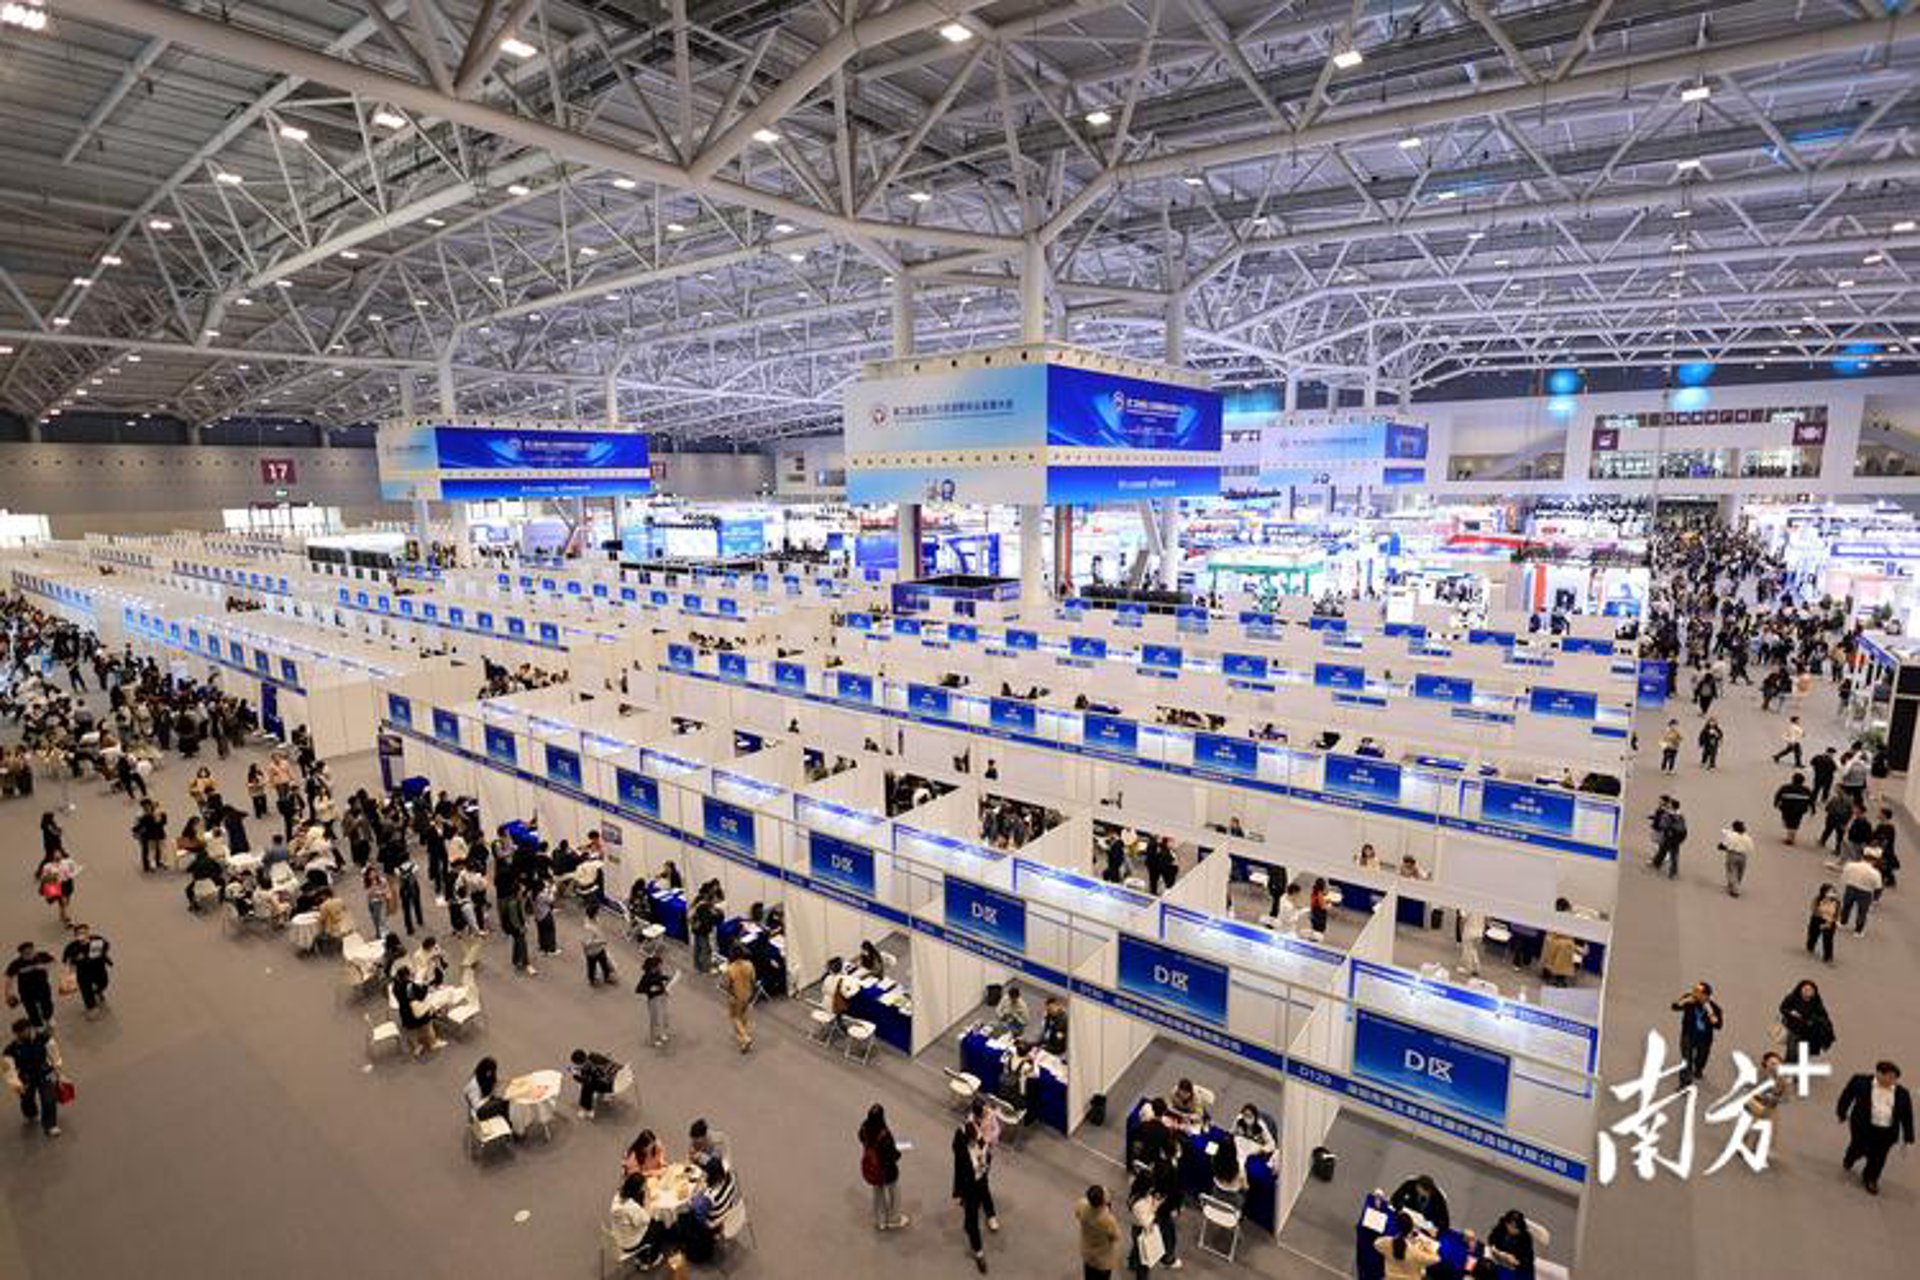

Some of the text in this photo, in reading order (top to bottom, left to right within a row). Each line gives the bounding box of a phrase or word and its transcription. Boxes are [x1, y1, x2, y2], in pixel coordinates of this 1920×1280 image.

[268, 463, 288, 479] 17
[972, 901, 998, 925] D区
[1154, 965, 1188, 991] D区
[1404, 1049, 1453, 1083] D区
